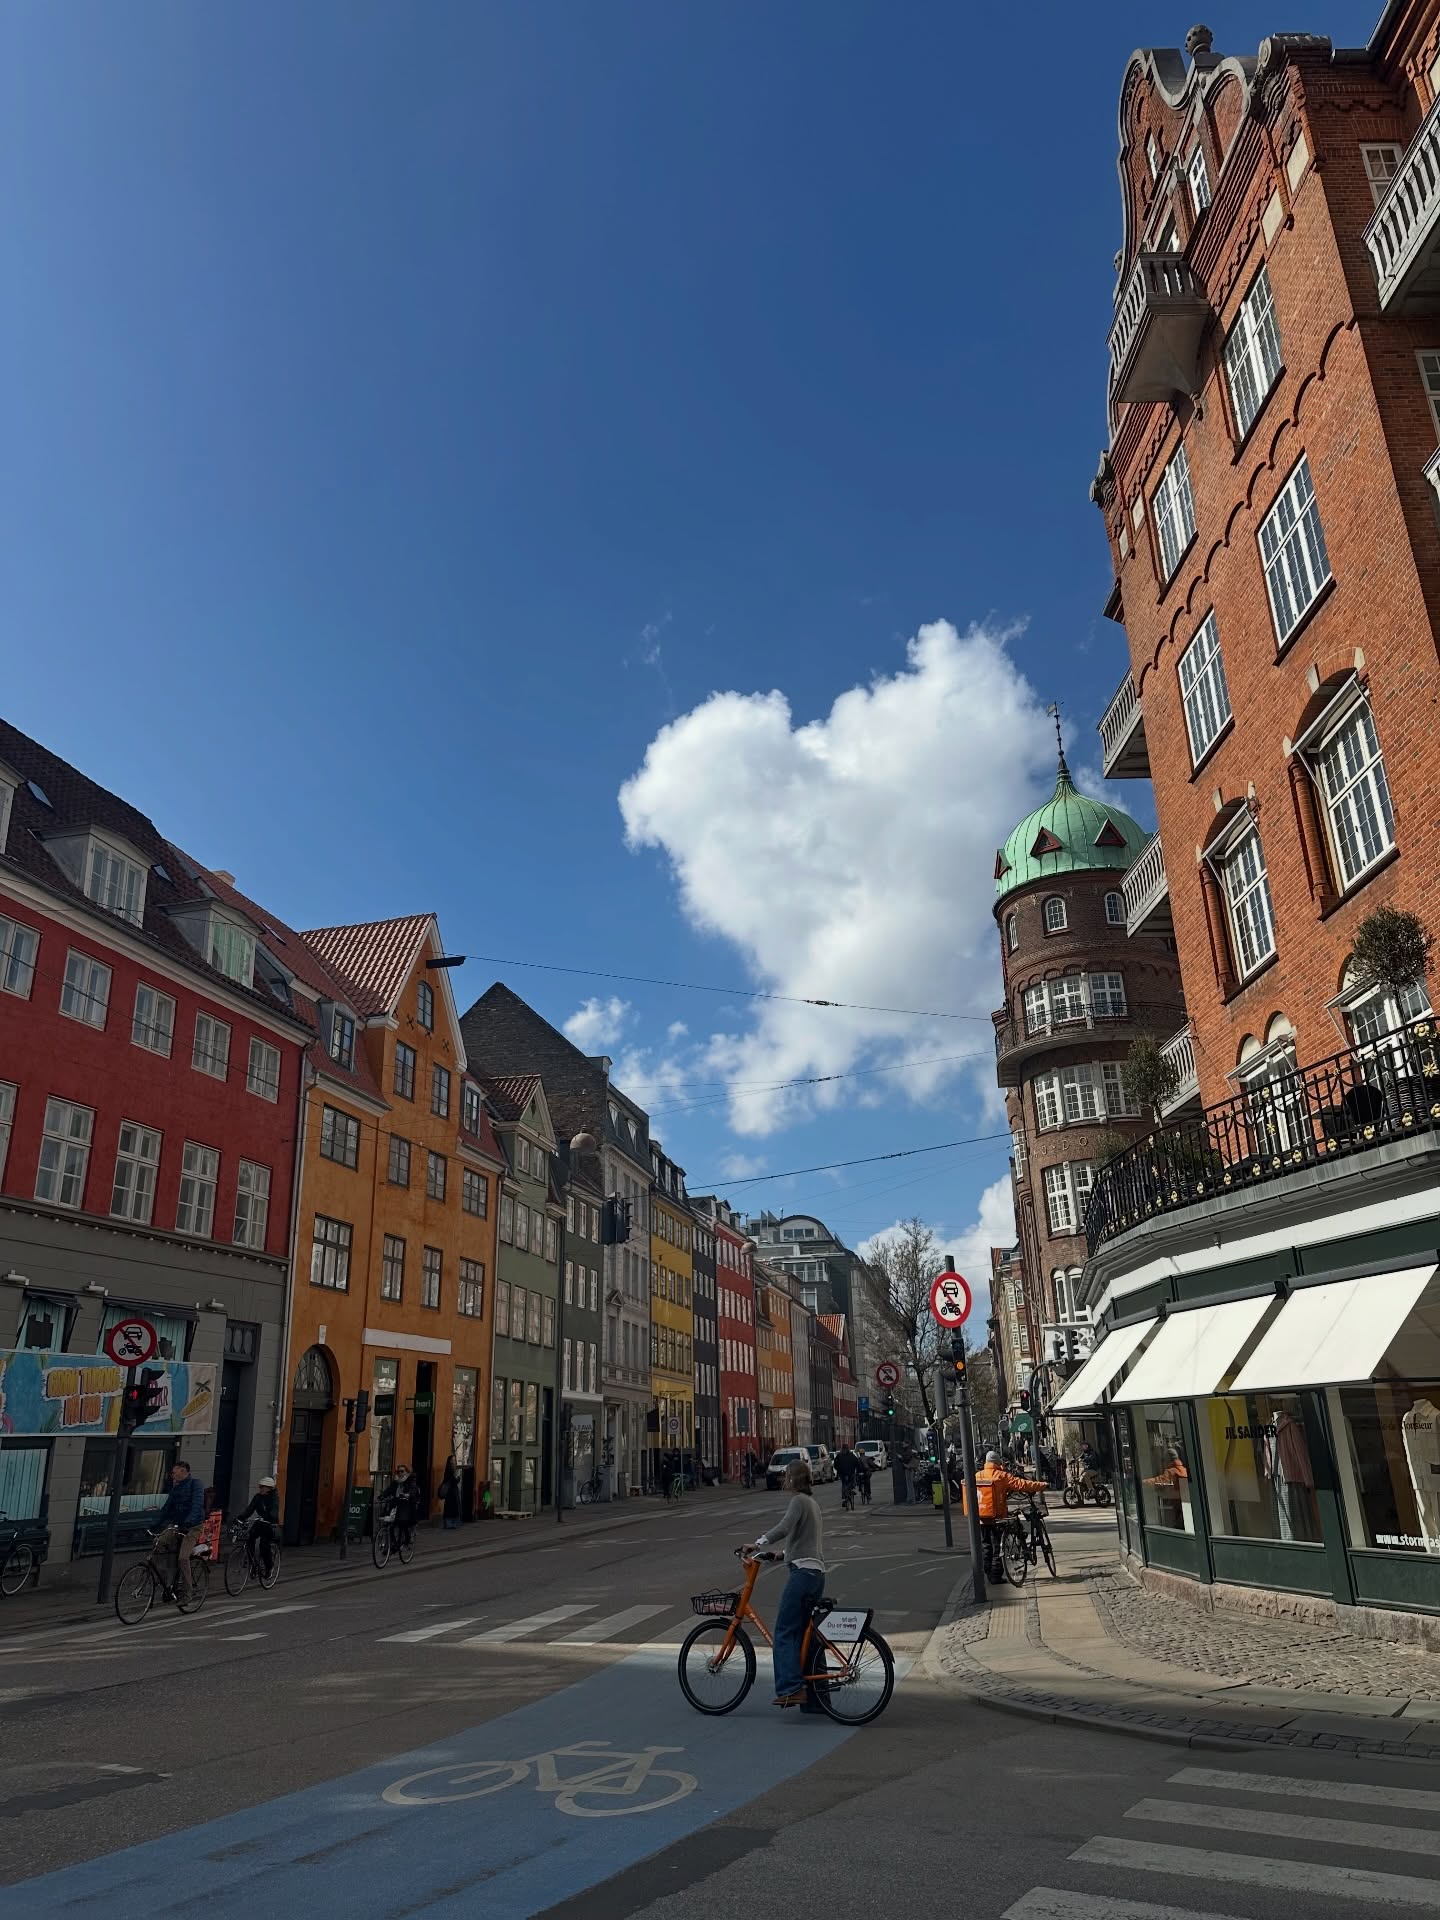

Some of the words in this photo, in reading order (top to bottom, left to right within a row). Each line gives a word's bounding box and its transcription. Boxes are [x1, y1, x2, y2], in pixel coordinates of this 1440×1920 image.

[415, 1399, 431, 1408] hari
[1225, 1426, 1238, 1440] JIL
[1238, 1424, 1278, 1439] SANDER
